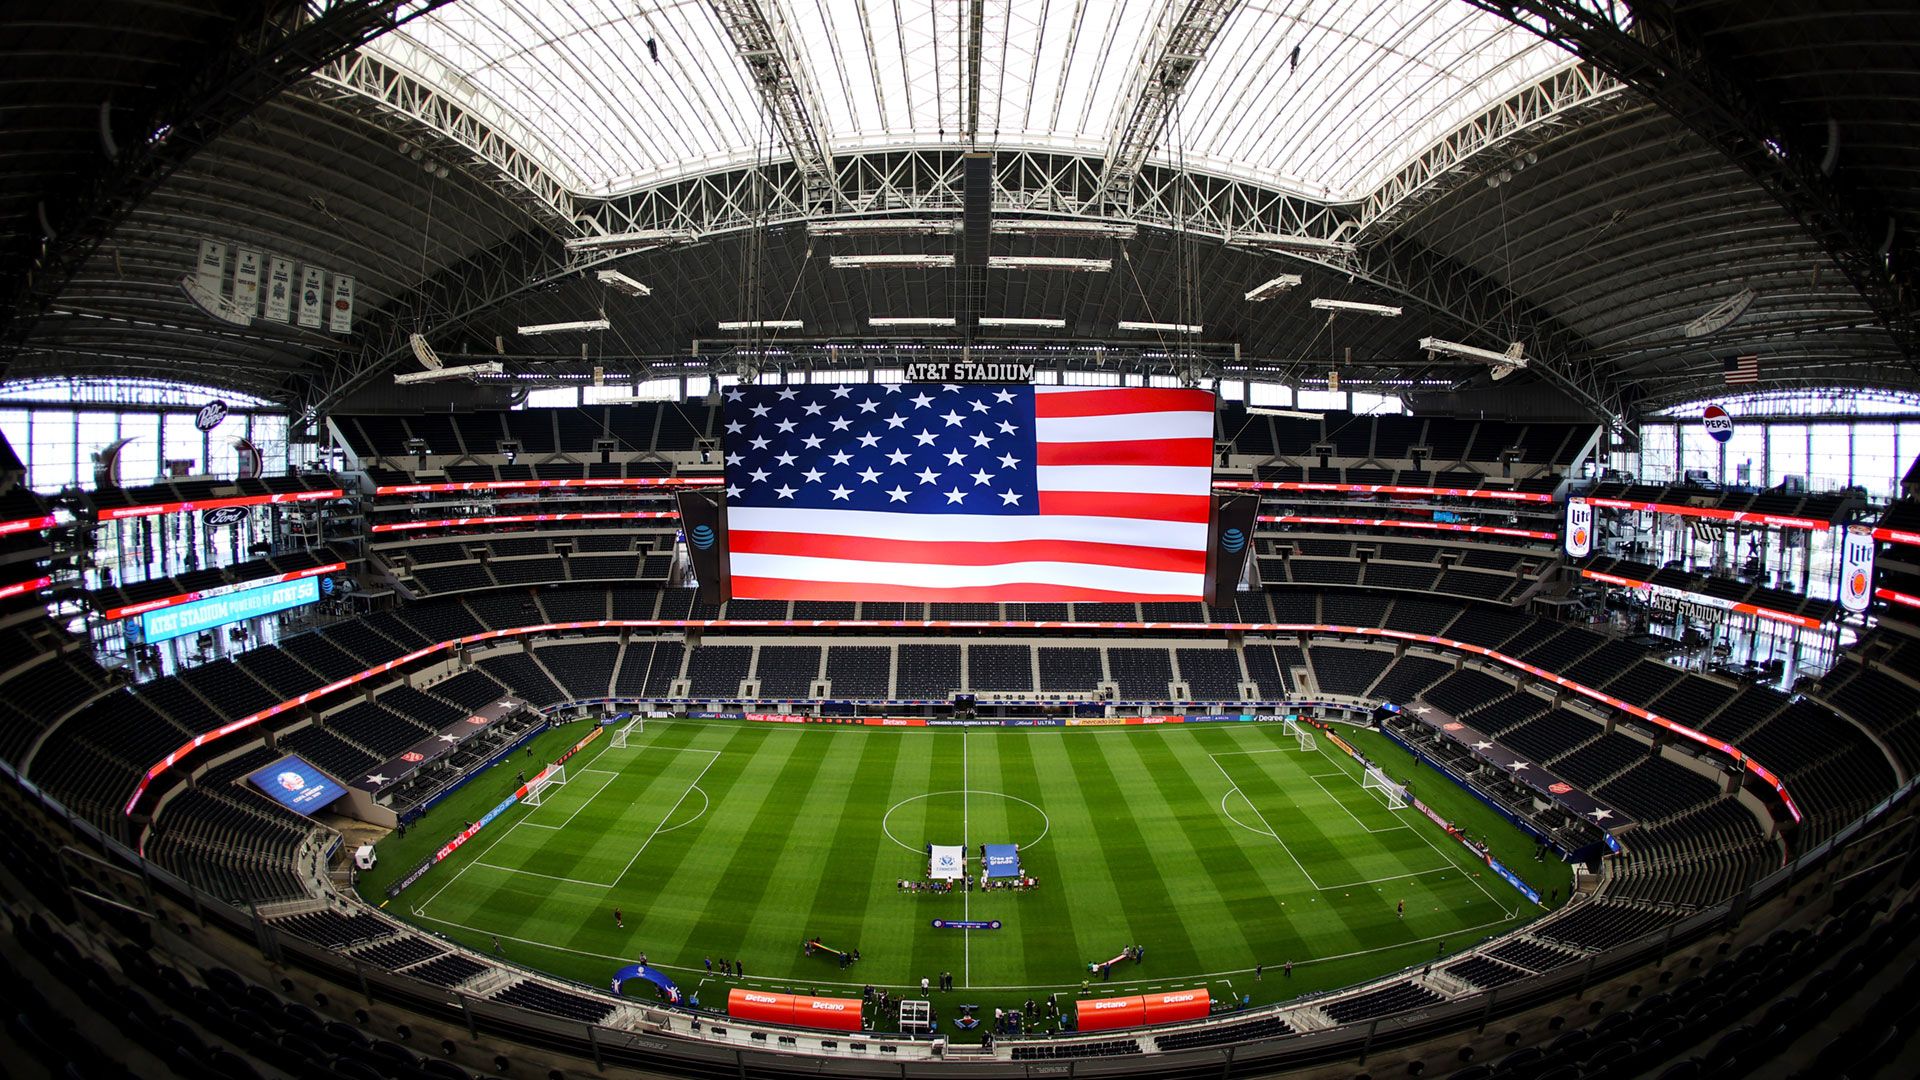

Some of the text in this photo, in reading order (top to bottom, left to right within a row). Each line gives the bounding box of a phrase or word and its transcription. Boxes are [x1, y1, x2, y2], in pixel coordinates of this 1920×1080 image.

[905, 363, 1035, 381] AT&T STADIUM
[209, 403, 222, 414] Dr
[197, 406, 226, 429] Pepper
[1705, 419, 1731, 429] PEPSI
[210, 508, 242, 524] Ford
[1572, 509, 1591, 526] Lite
[1691, 521, 1723, 544] Lite
[1849, 542, 1873, 567] Lite
[150, 615, 178, 636] AT&T
[180, 602, 229, 628] STADIUM
[272, 586, 298, 605] AT&T
[1654, 597, 1677, 613] AT&T
[1678, 602, 1723, 623] STADIUM
[1258, 714, 1283, 722] Degree
[437, 822, 481, 860] TCL TCL TCL
[417, 862, 430, 877] SPORT
[745, 994, 777, 1004] Betano
[812, 1001, 845, 1011] Betano
[1095, 1001, 1127, 1009] Betano
[1163, 994, 1194, 1004] Betano
